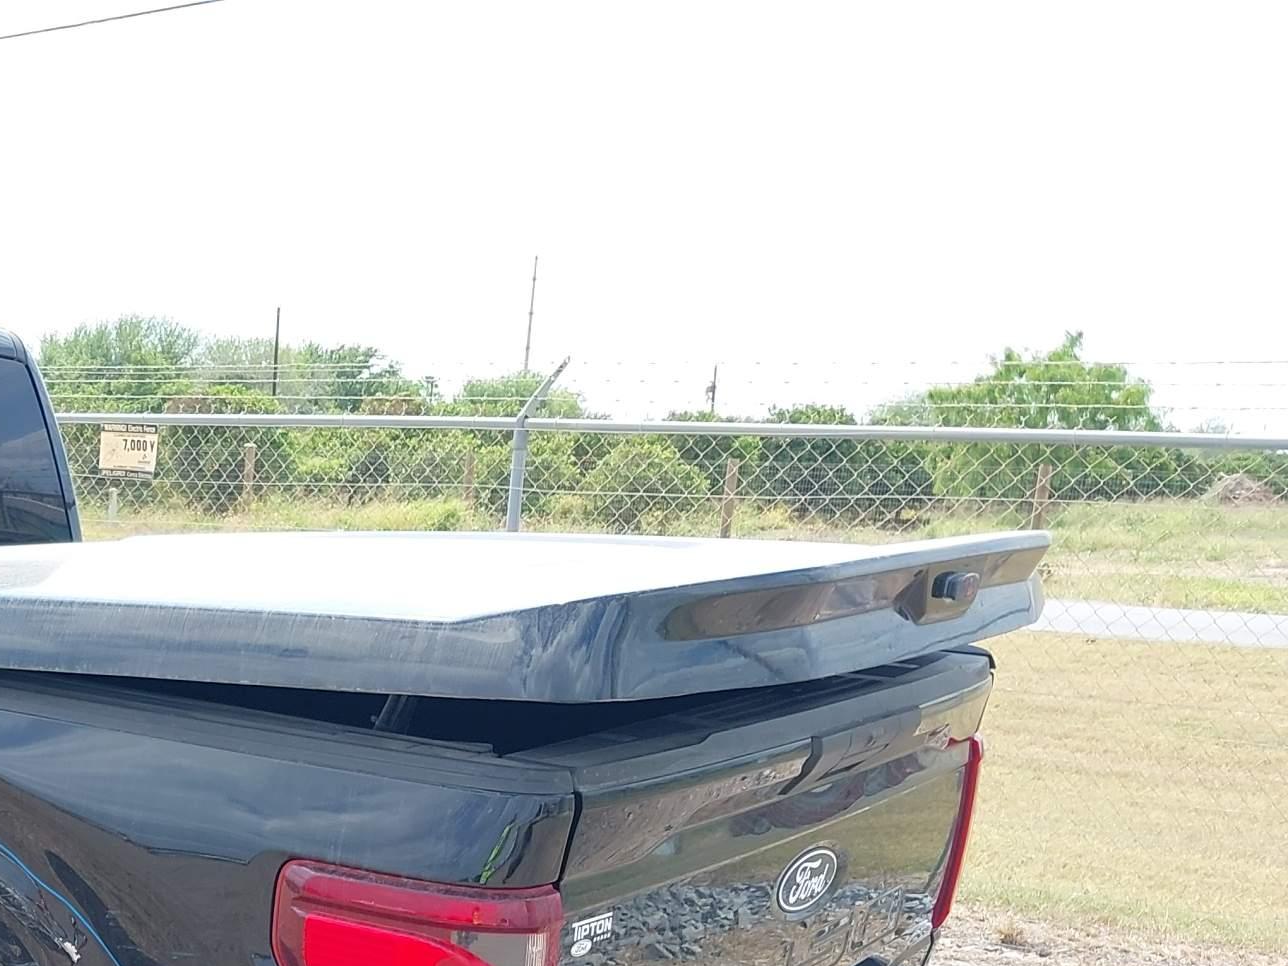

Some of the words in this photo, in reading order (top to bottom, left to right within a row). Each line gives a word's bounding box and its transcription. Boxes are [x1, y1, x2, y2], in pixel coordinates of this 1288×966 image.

[122, 439, 147, 452] 7,000
[788, 858, 829, 904] Ford
[572, 911, 613, 942] TIPTON
